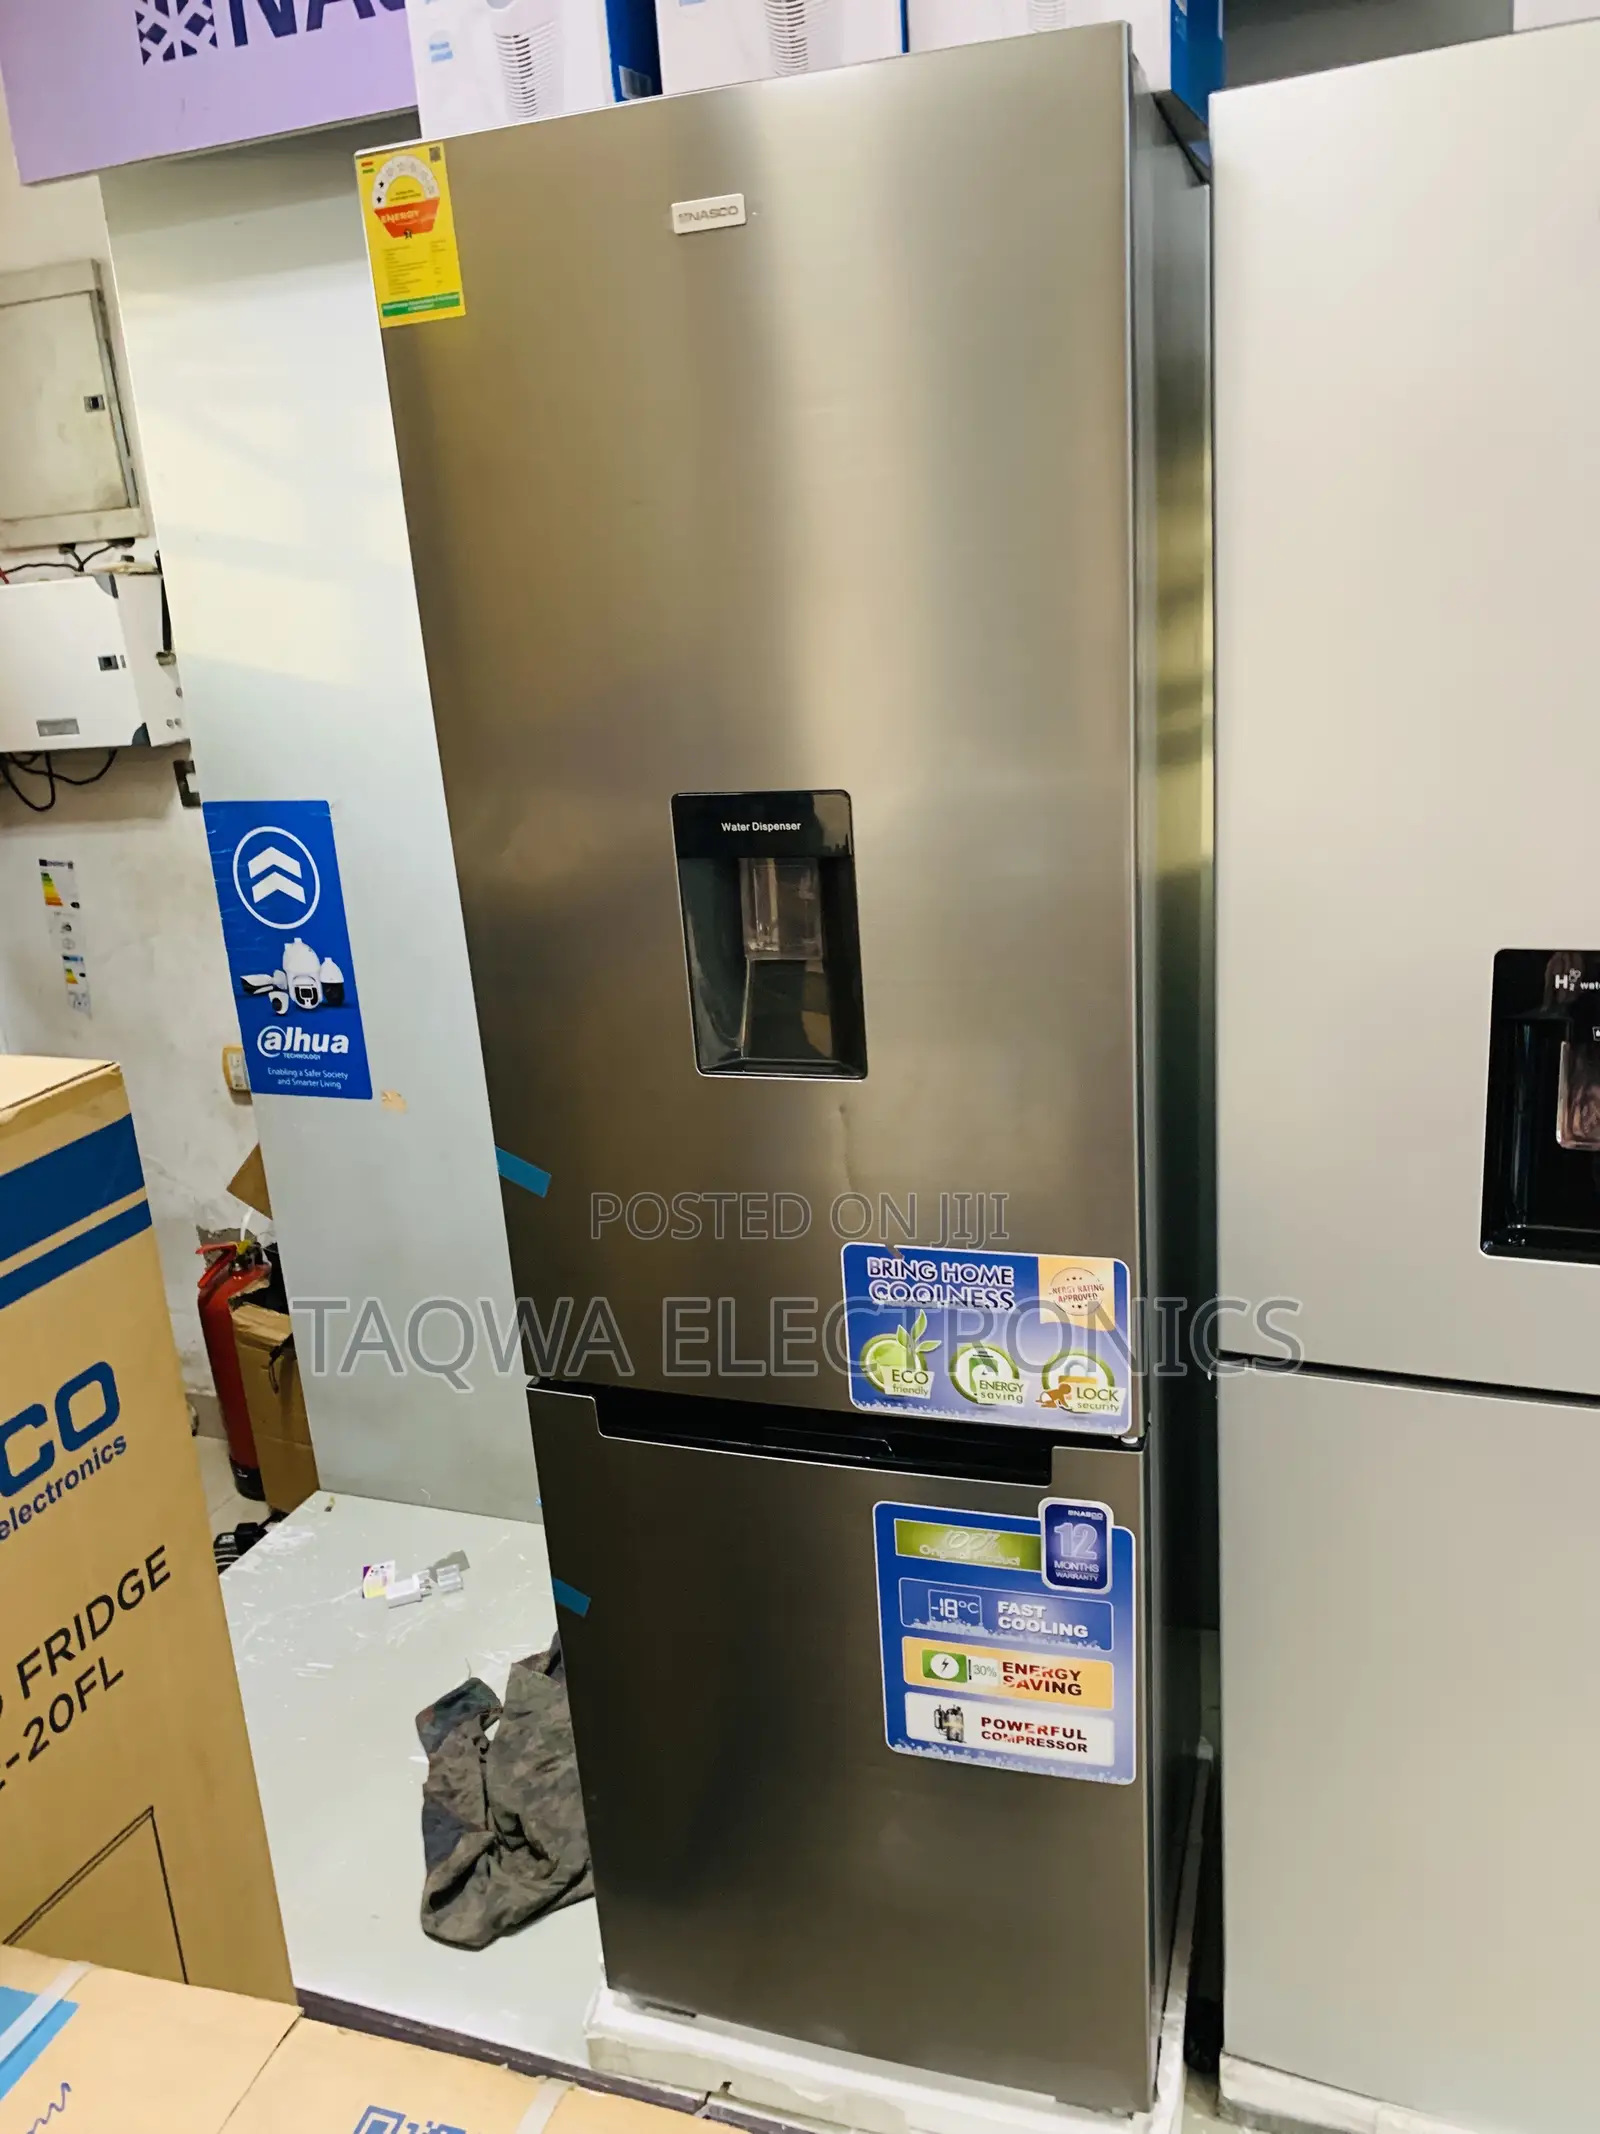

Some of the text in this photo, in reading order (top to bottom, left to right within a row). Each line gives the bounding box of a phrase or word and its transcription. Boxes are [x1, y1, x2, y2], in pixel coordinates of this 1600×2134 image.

[721, 821, 801, 833] Water Dispenser
[268, 1067, 298, 1078] Enabling
[304, 1068, 321, 1077] Safer
[322, 1070, 348, 1080] Society
[277, 1078, 342, 1090] and Smarter Living
[867, 1257, 1014, 1287] BRING HOME
[869, 1280, 1016, 1311] COOLNESS
[1058, 1292, 1098, 1303] APPROVED
[892, 1369, 929, 1385] ECO
[892, 1384, 929, 1397] friendly
[979, 1380, 1024, 1394] ENERGY
[1076, 1386, 1120, 1402] LOCK
[980, 1390, 1023, 1404] saving
[1077, 1400, 1120, 1412] security
[0, 1435, 127, 1541] electronics
[1054, 1522, 1098, 1560] 12
[1054, 1560, 1100, 1573] MONTHS
[1055, 1570, 1100, 1581] WARRANTY
[997, 1601, 1047, 1619] FAST
[16, 1545, 171, 1700] FRIDGE
[998, 1616, 1089, 1638] COOLING
[973, 1663, 998, 1678] 30%
[1002, 1661, 1082, 1682] ENERGY
[1003, 1675, 1082, 1696] SAVING
[981, 1716, 1087, 1741] POWERFUL
[981, 1730, 1088, 1753] COMPRESSOR
